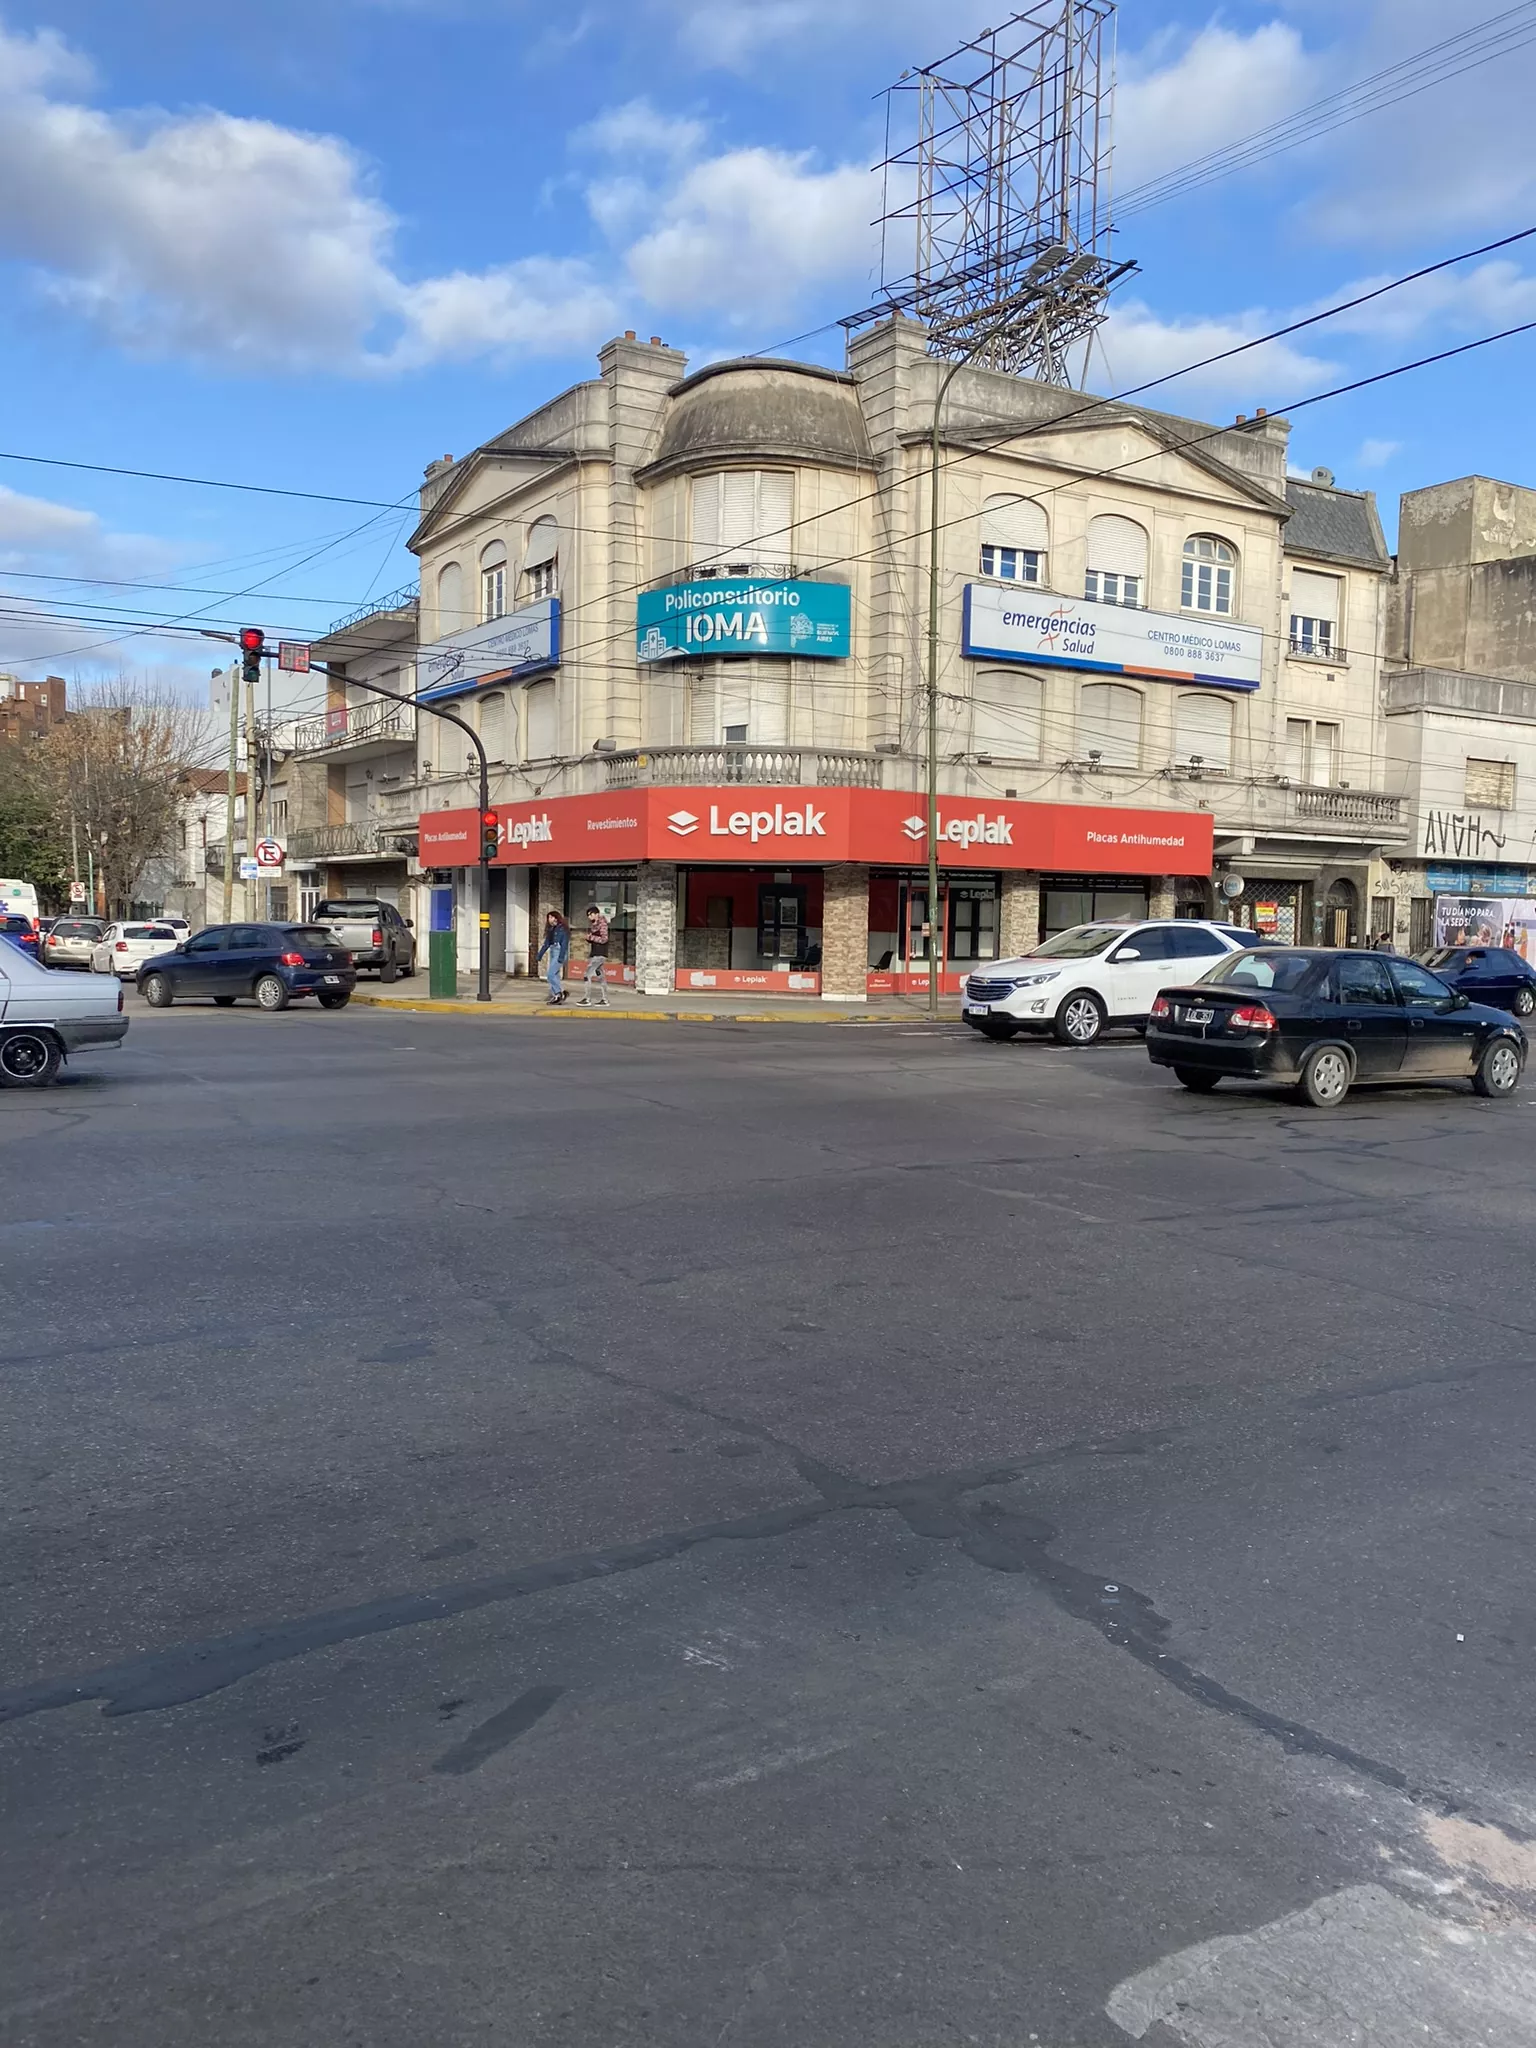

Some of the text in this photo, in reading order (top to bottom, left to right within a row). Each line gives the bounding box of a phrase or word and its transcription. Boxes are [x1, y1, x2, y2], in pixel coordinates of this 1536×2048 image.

[665, 585, 801, 613] Policonsultorio
[686, 611, 769, 645] IOMA
[1003, 612, 1097, 637] emergencias
[1062, 638, 1095, 655] Salud
[1147, 630, 1241, 652] CENTRO MÉDICO LOMAS
[1164, 645, 1225, 662] 0800 888 3637
[507, 813, 553, 850] Leplak
[587, 817, 638, 831] Revestimientos
[710, 803, 827, 843] Leplak
[936, 811, 1014, 850] Leplak
[1087, 831, 1185, 847] Placas Antihumedad
[1442, 907, 1451, 916] TU
[1452, 904, 1464, 916] DÍA
[1465, 907, 1476, 917] NO
[1441, 917, 1450, 927] LA
[1451, 917, 1464, 927] SED
[742, 975, 767, 986] Leplak
